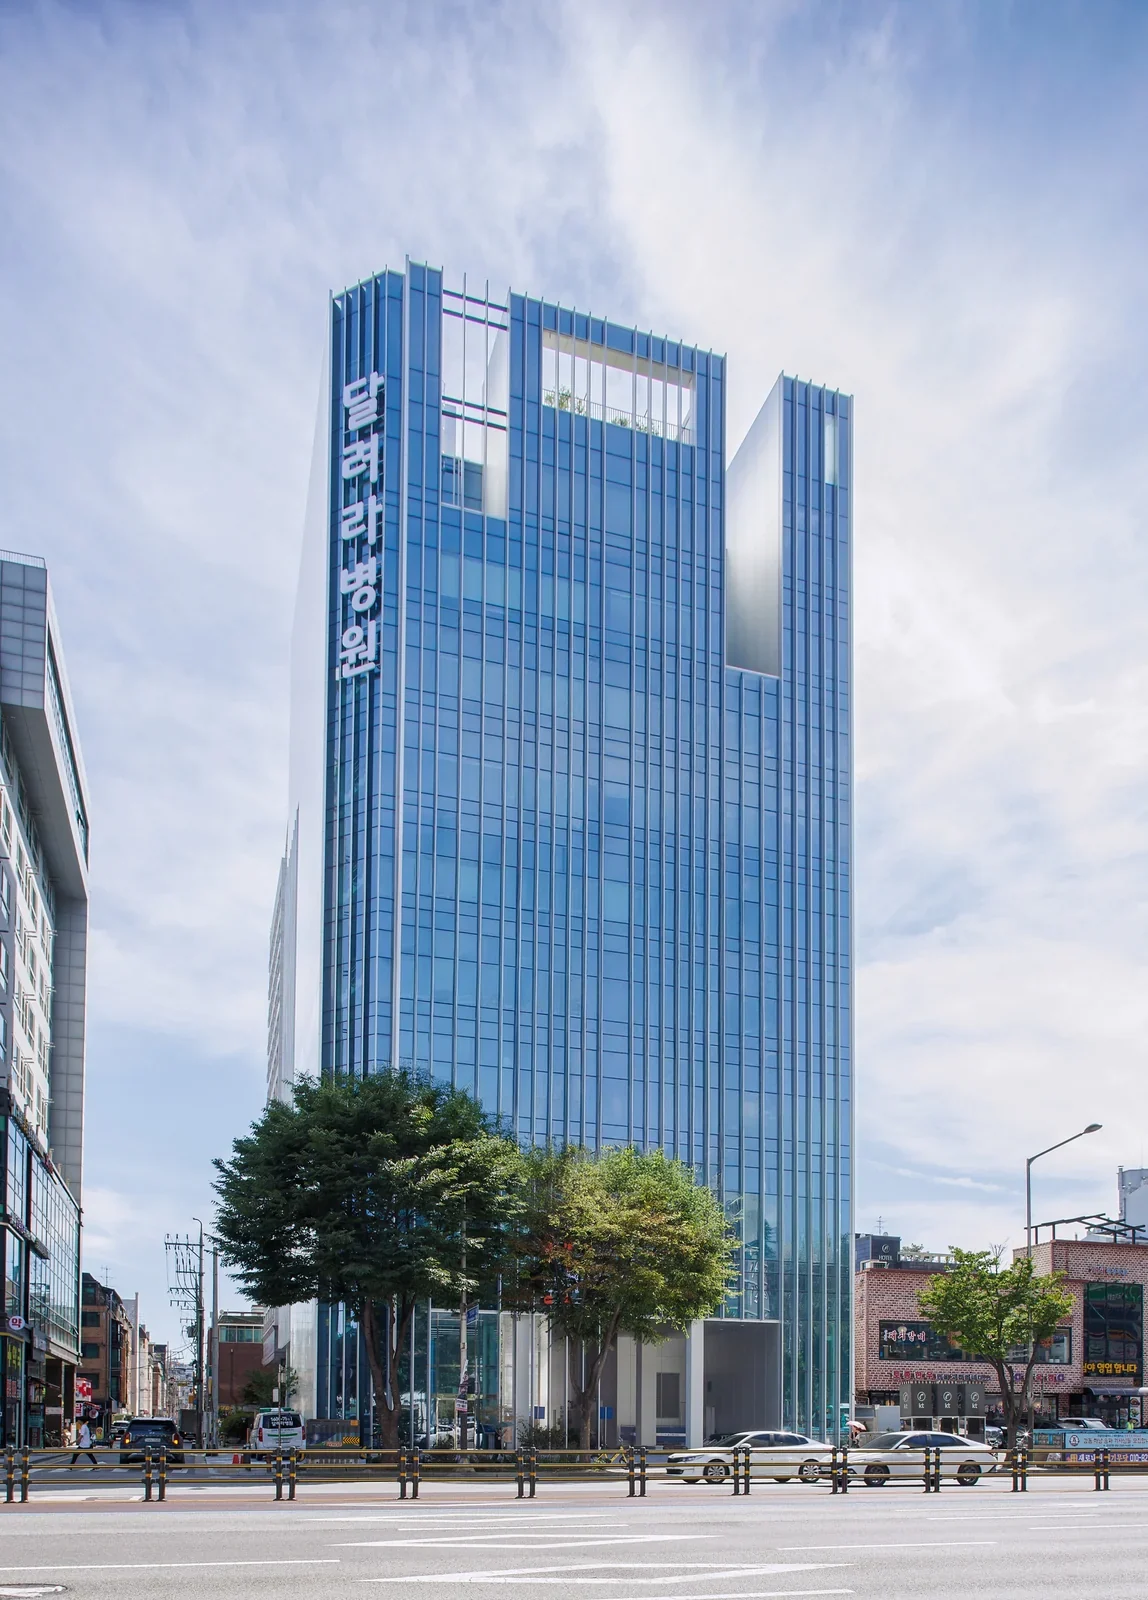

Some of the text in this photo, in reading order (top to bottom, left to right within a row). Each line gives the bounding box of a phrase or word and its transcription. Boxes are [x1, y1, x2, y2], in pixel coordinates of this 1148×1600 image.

[339, 371, 385, 679] 달려라병원
[11, 1318, 22, 1327] 약
[1096, 1362, 1113, 1374] 영업
[1113, 1362, 1138, 1374] 합니다
